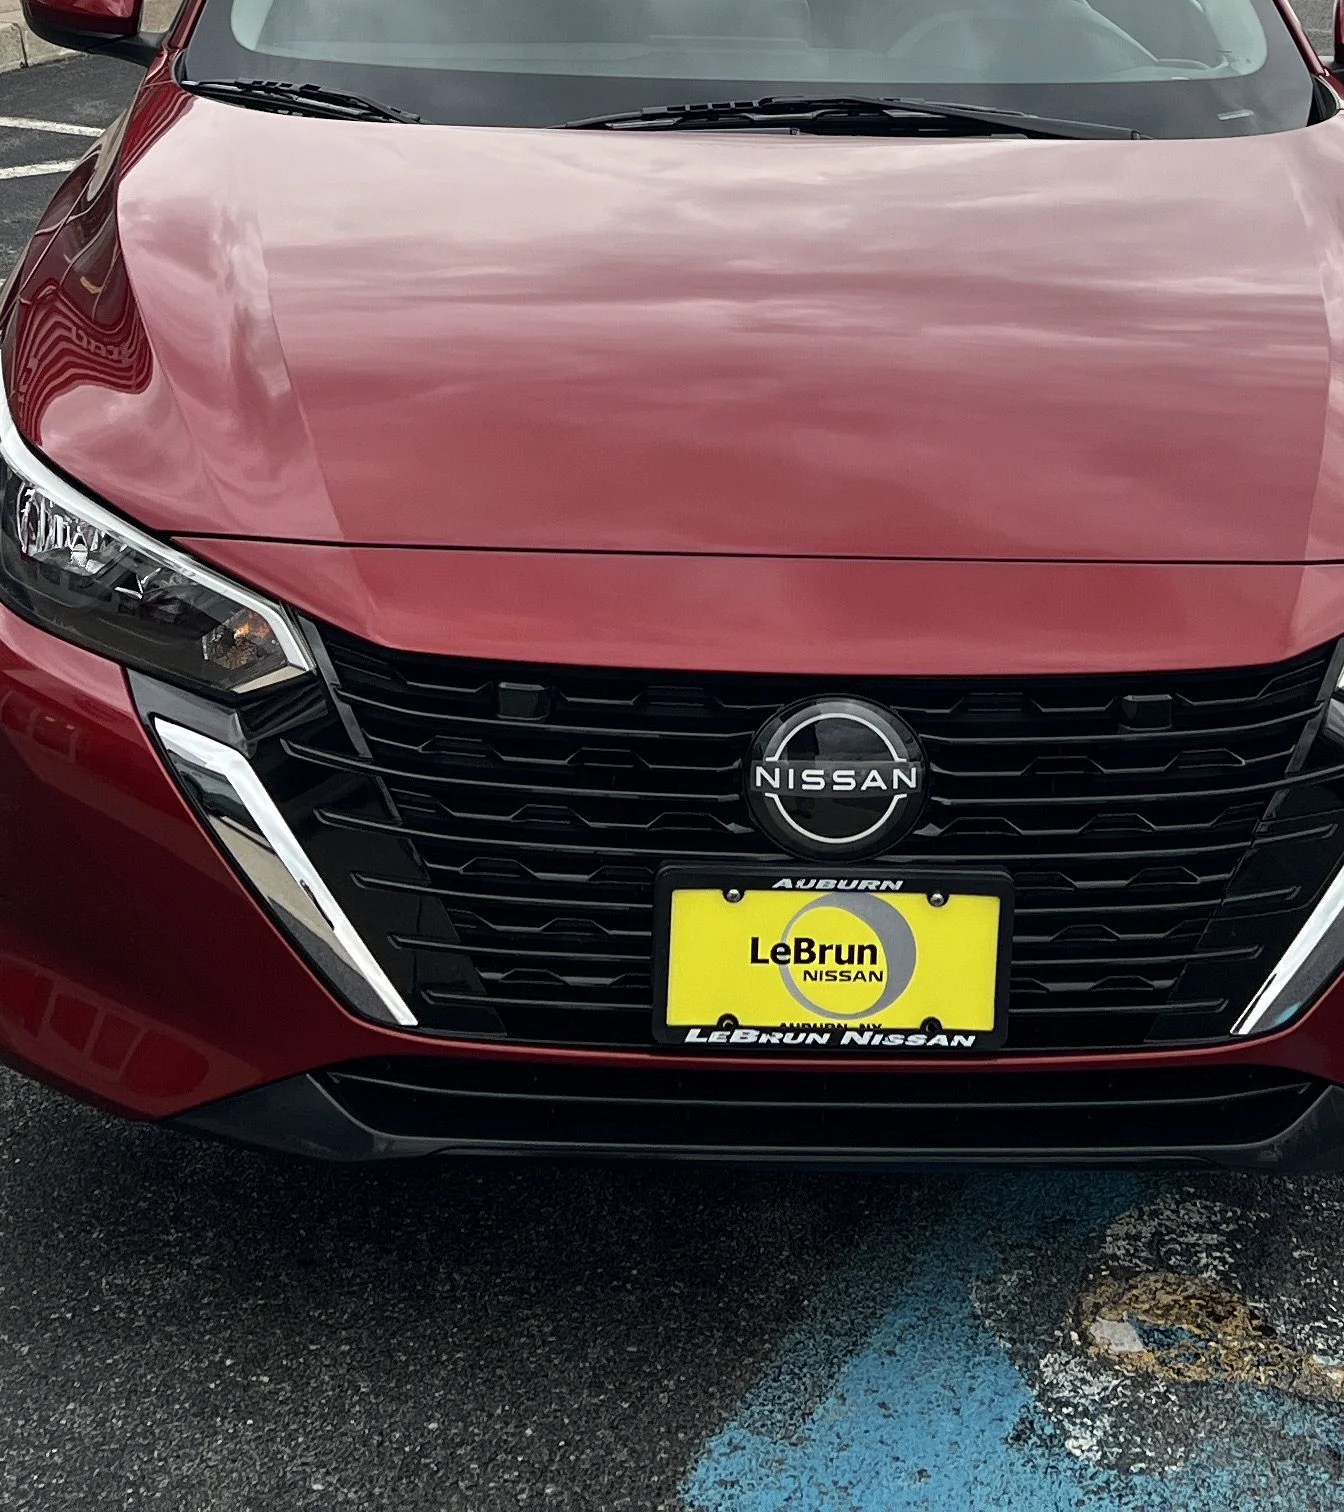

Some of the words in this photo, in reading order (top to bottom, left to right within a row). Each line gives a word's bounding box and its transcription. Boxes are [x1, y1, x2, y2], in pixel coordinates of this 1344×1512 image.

[756, 766, 918, 791] NISSAN
[772, 878, 904, 891] AUBURN
[750, 937, 878, 965] LeBrun
[803, 970, 883, 983] NISSAN
